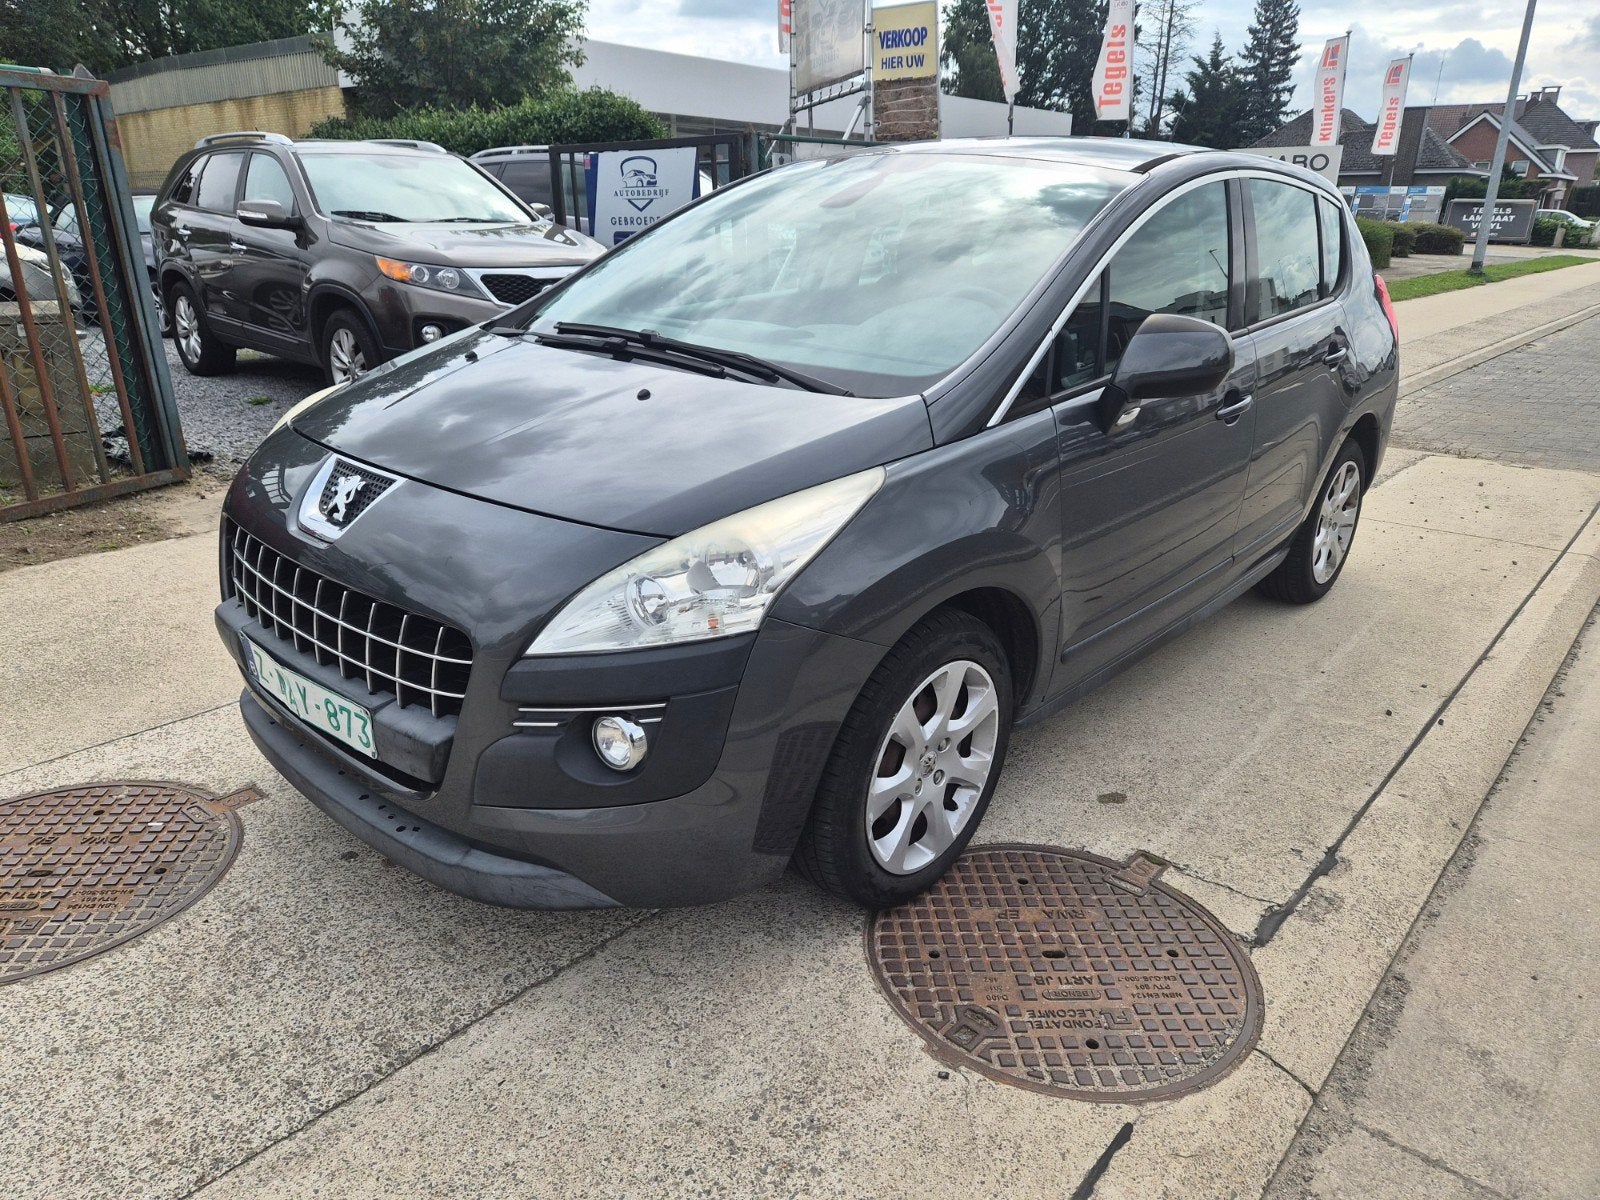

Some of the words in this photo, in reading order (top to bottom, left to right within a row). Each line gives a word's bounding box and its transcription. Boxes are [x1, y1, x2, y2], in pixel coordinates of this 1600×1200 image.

[879, 26, 928, 49] VERKOOP
[881, 56, 903, 69] HIER
[906, 54, 925, 67] UW
[1098, 24, 1127, 108] Tegels
[1319, 77, 1336, 141] Klinkers
[1377, 97, 1400, 148] Tegels
[614, 189, 670, 197] AUTOBEDRIJF
[1471, 222, 1503, 230] VIYL
[997, 909, 1020, 920] EP
[1042, 909, 1087, 920] RWA
[1033, 975, 1054, 985] JB
[1057, 975, 1094, 985] ARTI
[1026, 1009, 1094, 1018] LECOMTE
[1024, 1019, 1103, 1030] FONDATEL
